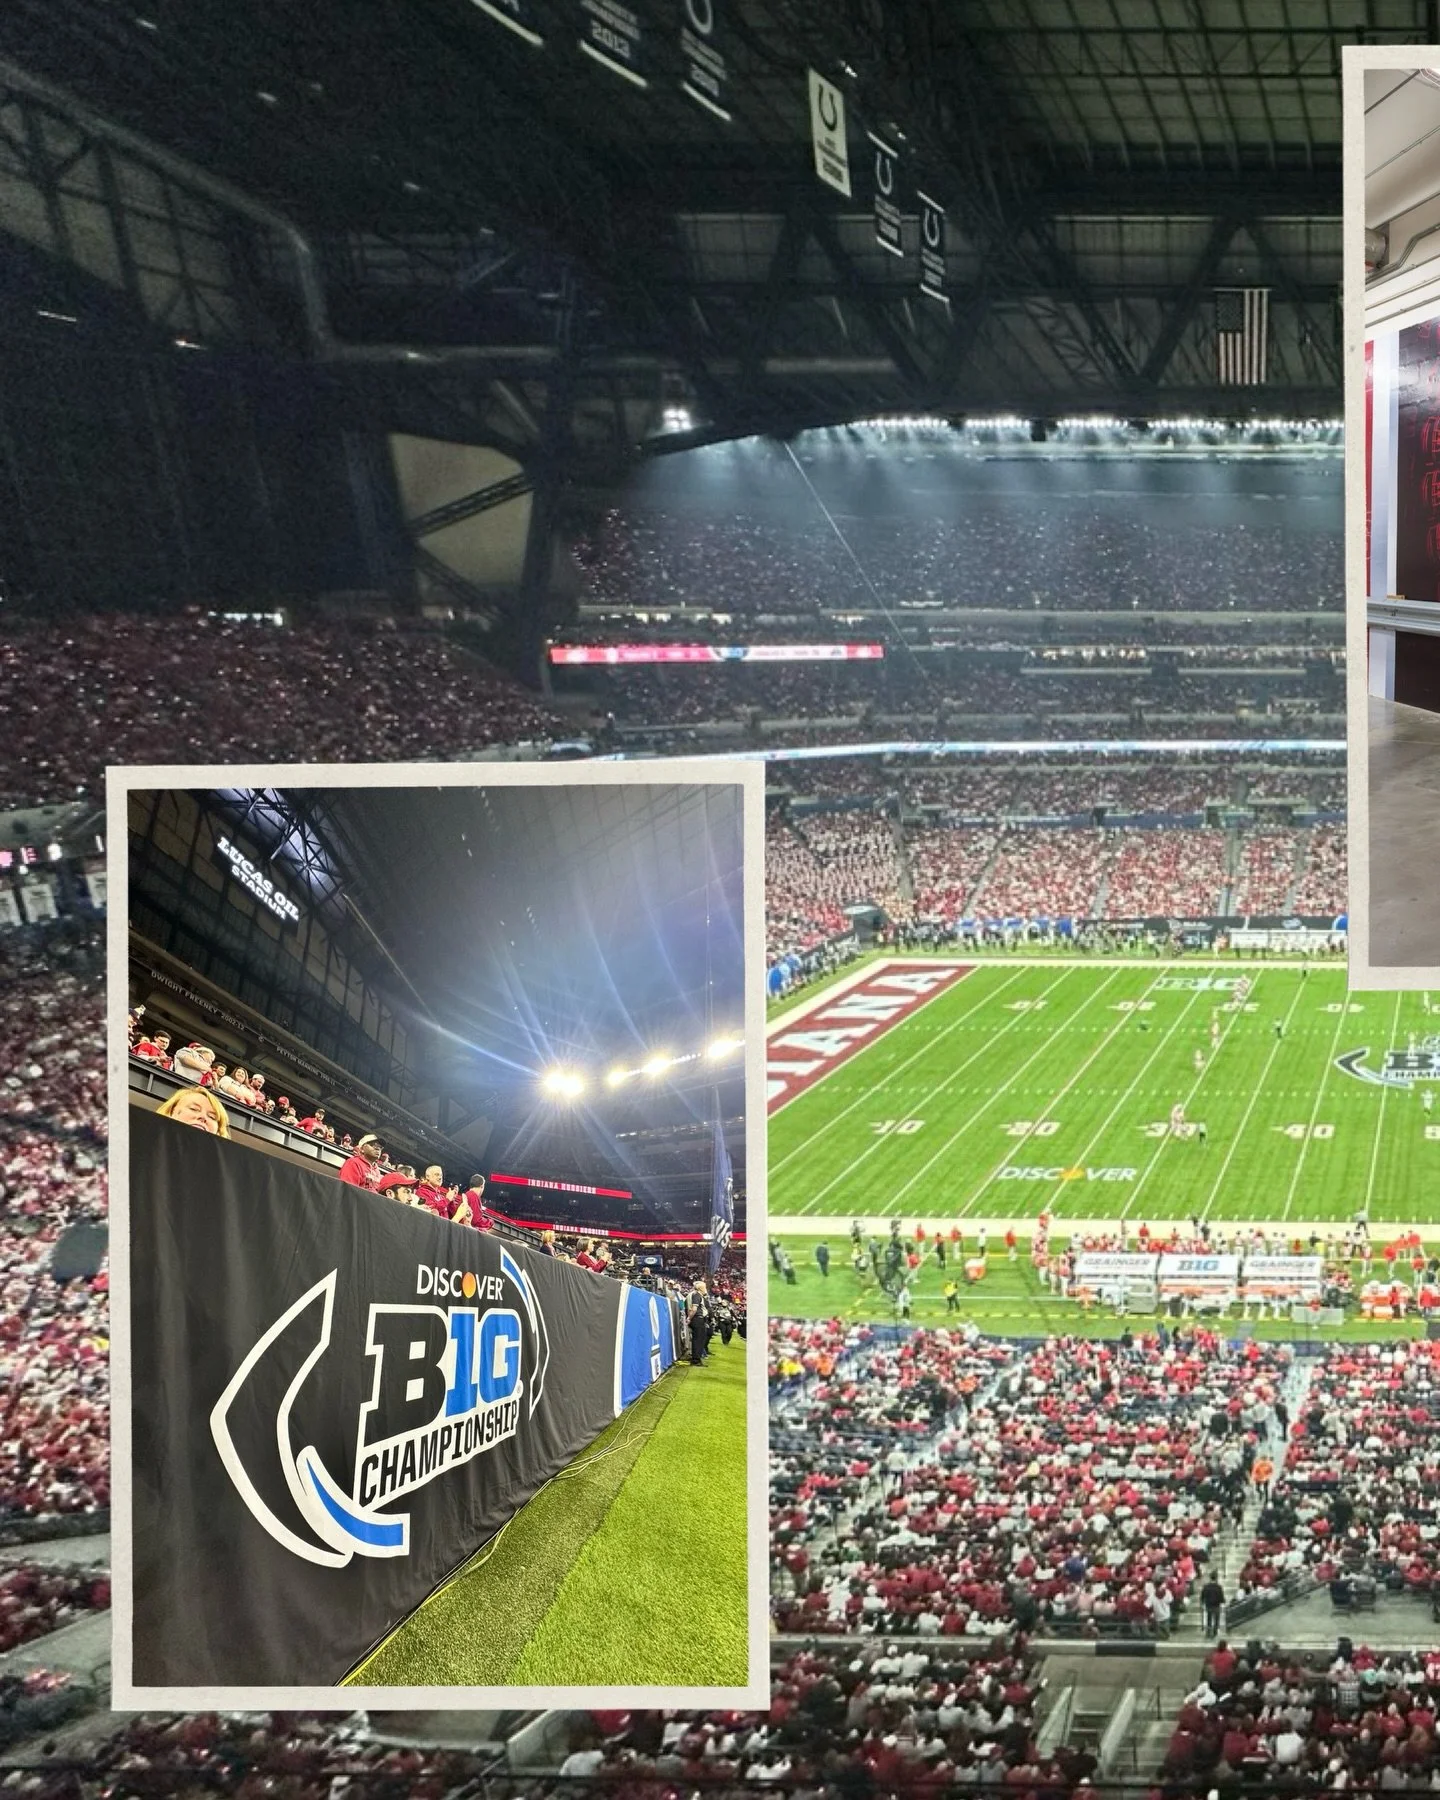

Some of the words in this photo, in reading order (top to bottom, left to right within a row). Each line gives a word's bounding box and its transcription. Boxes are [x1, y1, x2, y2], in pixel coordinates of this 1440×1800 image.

[217, 837, 273, 894] LUCAS
[274, 892, 299, 920] OIL
[231, 865, 286, 919] STADIUM
[151, 970, 185, 993] DWIGHT
[184, 990, 219, 1014] FREENEY
[1284, 1124, 1336, 1139] 40
[527, 1178, 559, 1190] INDIANA
[998, 1166, 1137, 1181] DISCOVER
[416, 1264, 504, 1301] DISCOVER
[358, 1399, 518, 1508] CHAMPIONSHIP
